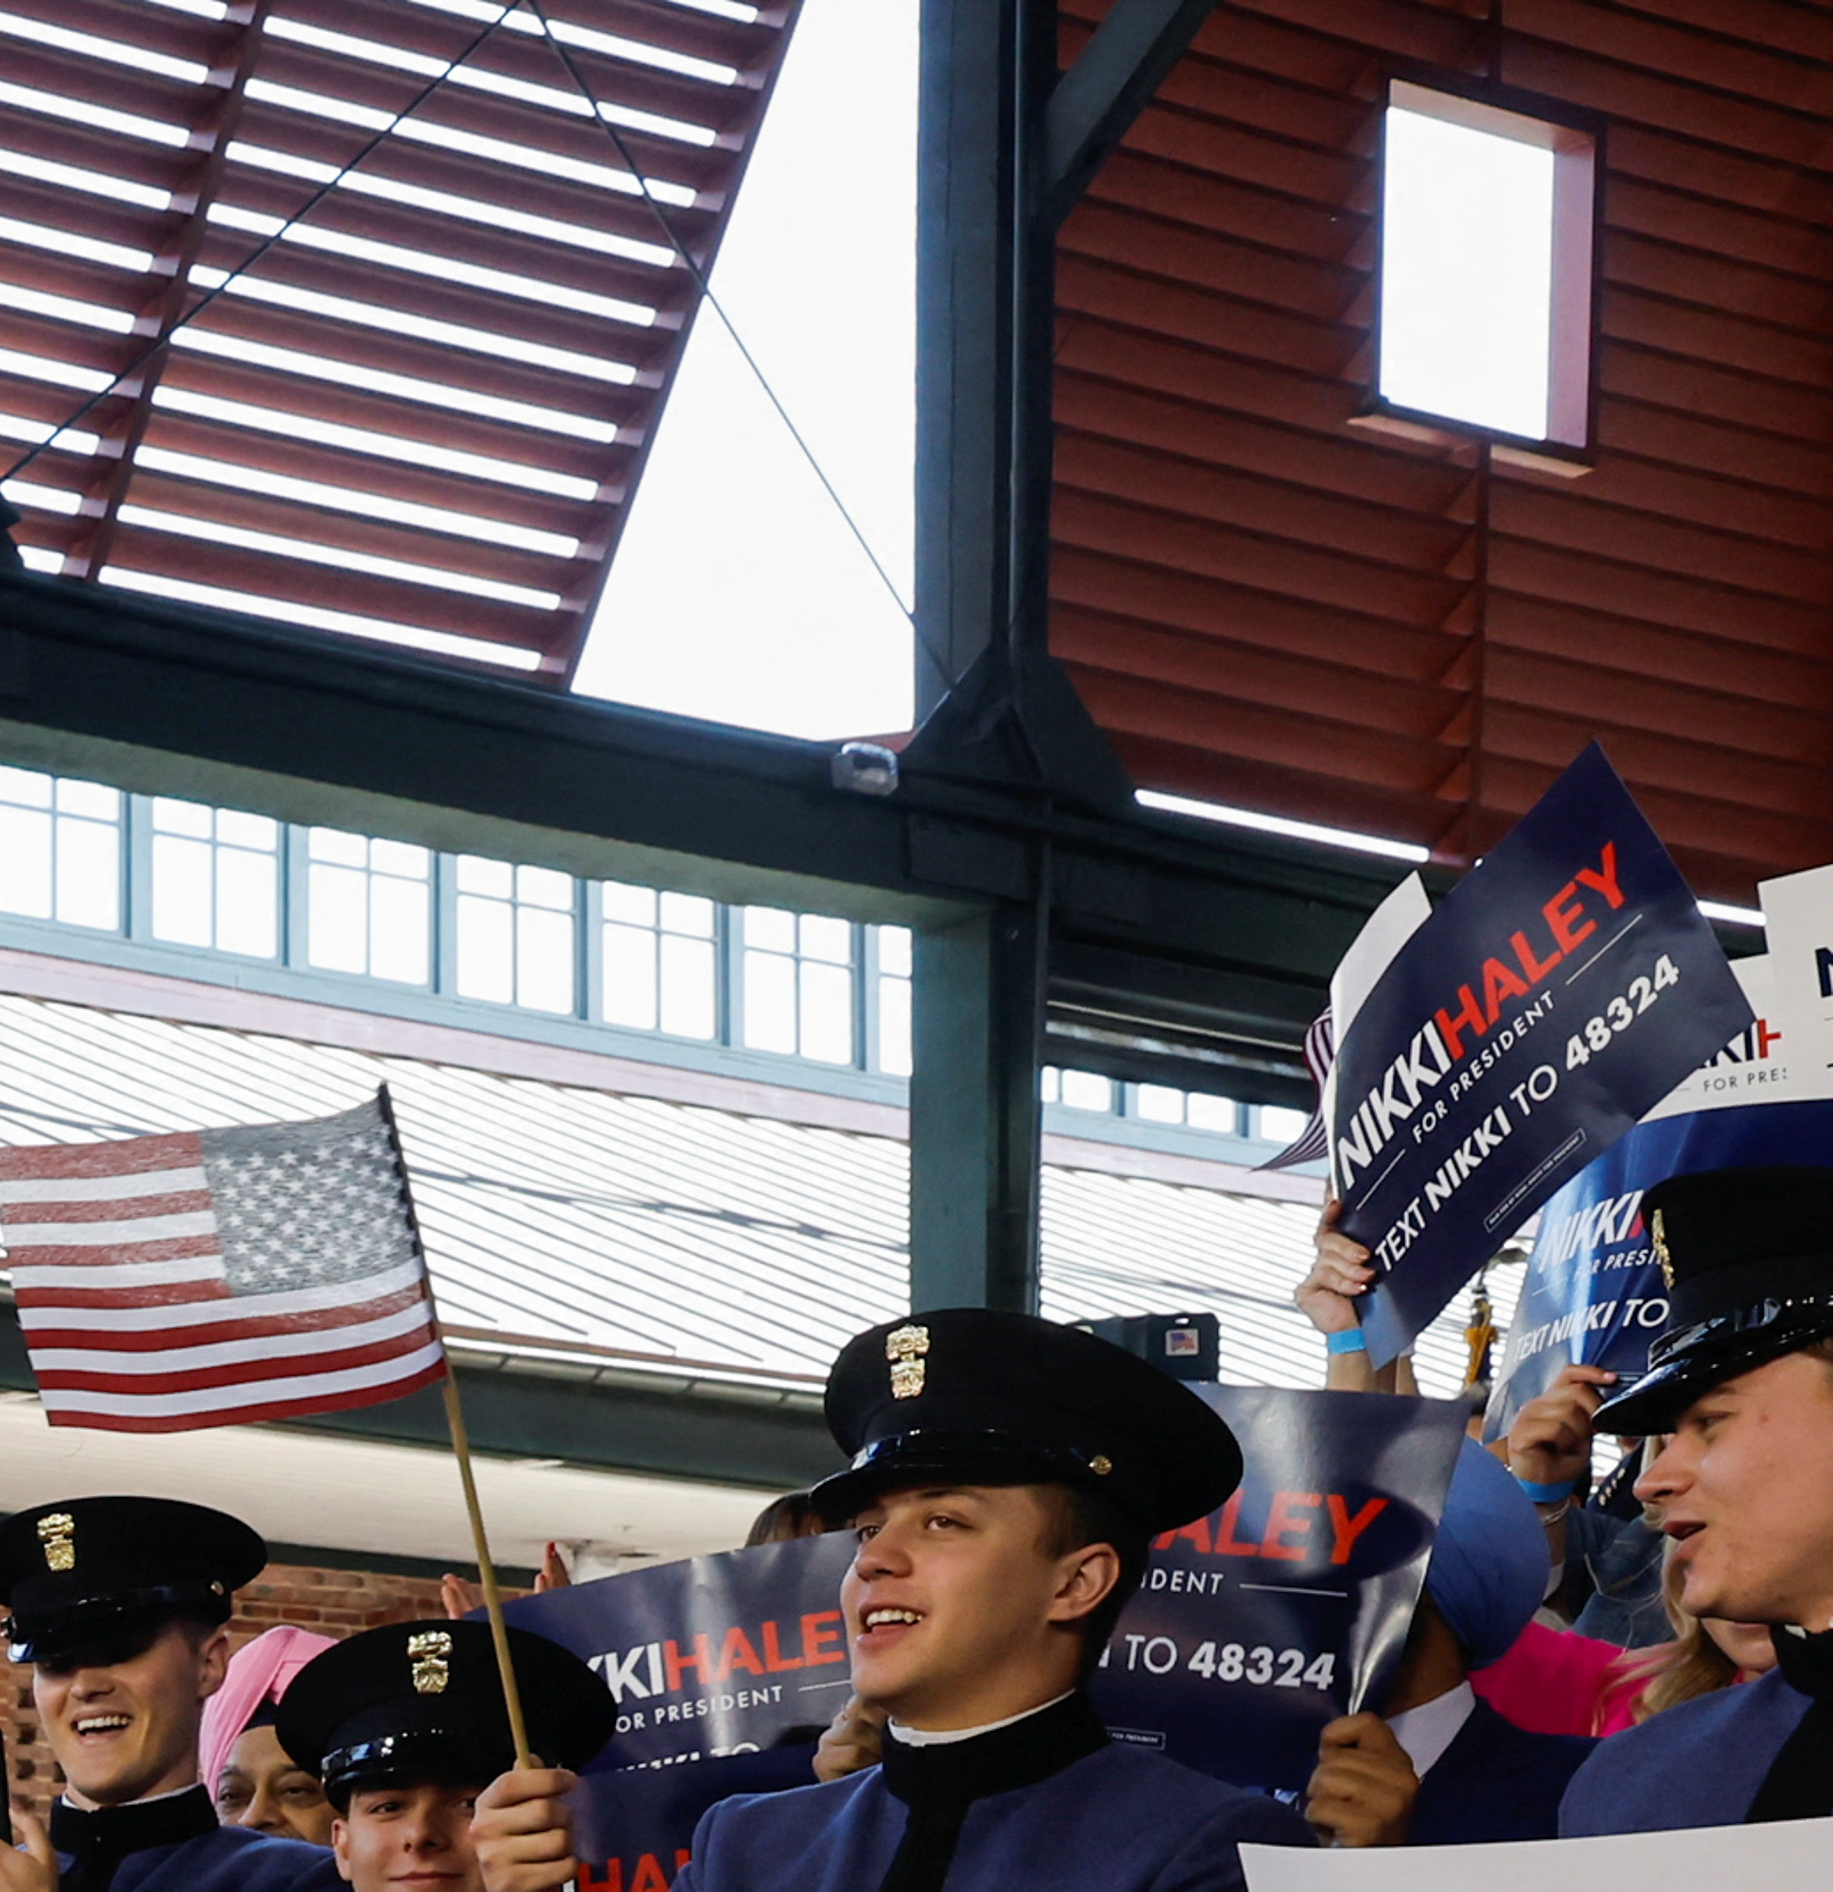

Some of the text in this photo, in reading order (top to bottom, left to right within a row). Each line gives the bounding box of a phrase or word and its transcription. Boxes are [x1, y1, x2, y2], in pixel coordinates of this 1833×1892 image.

[1334, 840, 1626, 1190] NIKKIHALEY
[1412, 1097, 1447, 1145] FOR
[1450, 989, 1556, 1102] PRESIDENT
[1703, 1076, 1739, 1093] FOR
[1375, 1197, 1427, 1272] TEXT
[1423, 1109, 1513, 1213] NIKKI
[1510, 1064, 1559, 1118] TO
[1564, 953, 1680, 1073] 48324
[1604, 1249, 1672, 1276] PRESI
[1622, 1298, 1671, 1328] TO
[1125, 1634, 1177, 1674] TO
[1187, 1641, 1336, 1691] 48324
[655, 1685, 783, 1724] PRESIDENT
